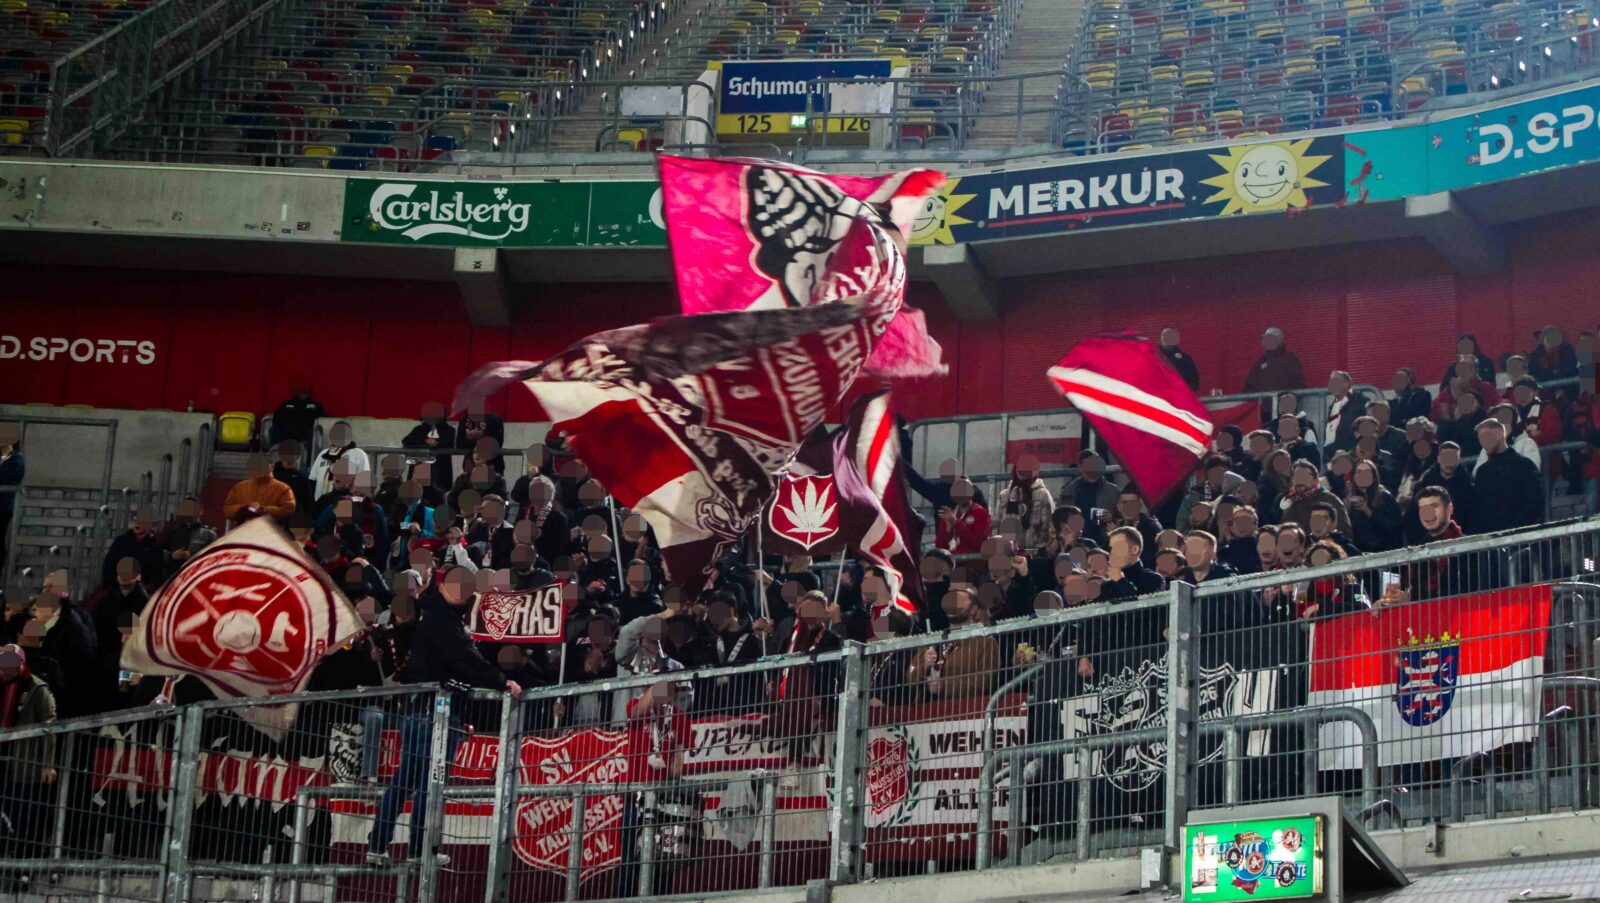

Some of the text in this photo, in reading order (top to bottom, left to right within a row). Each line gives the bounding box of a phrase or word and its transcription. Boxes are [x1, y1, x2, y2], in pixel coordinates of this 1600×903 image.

[737, 114, 772, 133] 125
[840, 115, 871, 131] 126
[1479, 104, 1600, 166] D.SP
[369, 182, 532, 233] Carlsberg
[988, 167, 1186, 220] MERKUR
[0, 335, 156, 365] D.SPORTS
[929, 728, 1026, 755] WEHEN
[539, 746, 574, 785] SV
